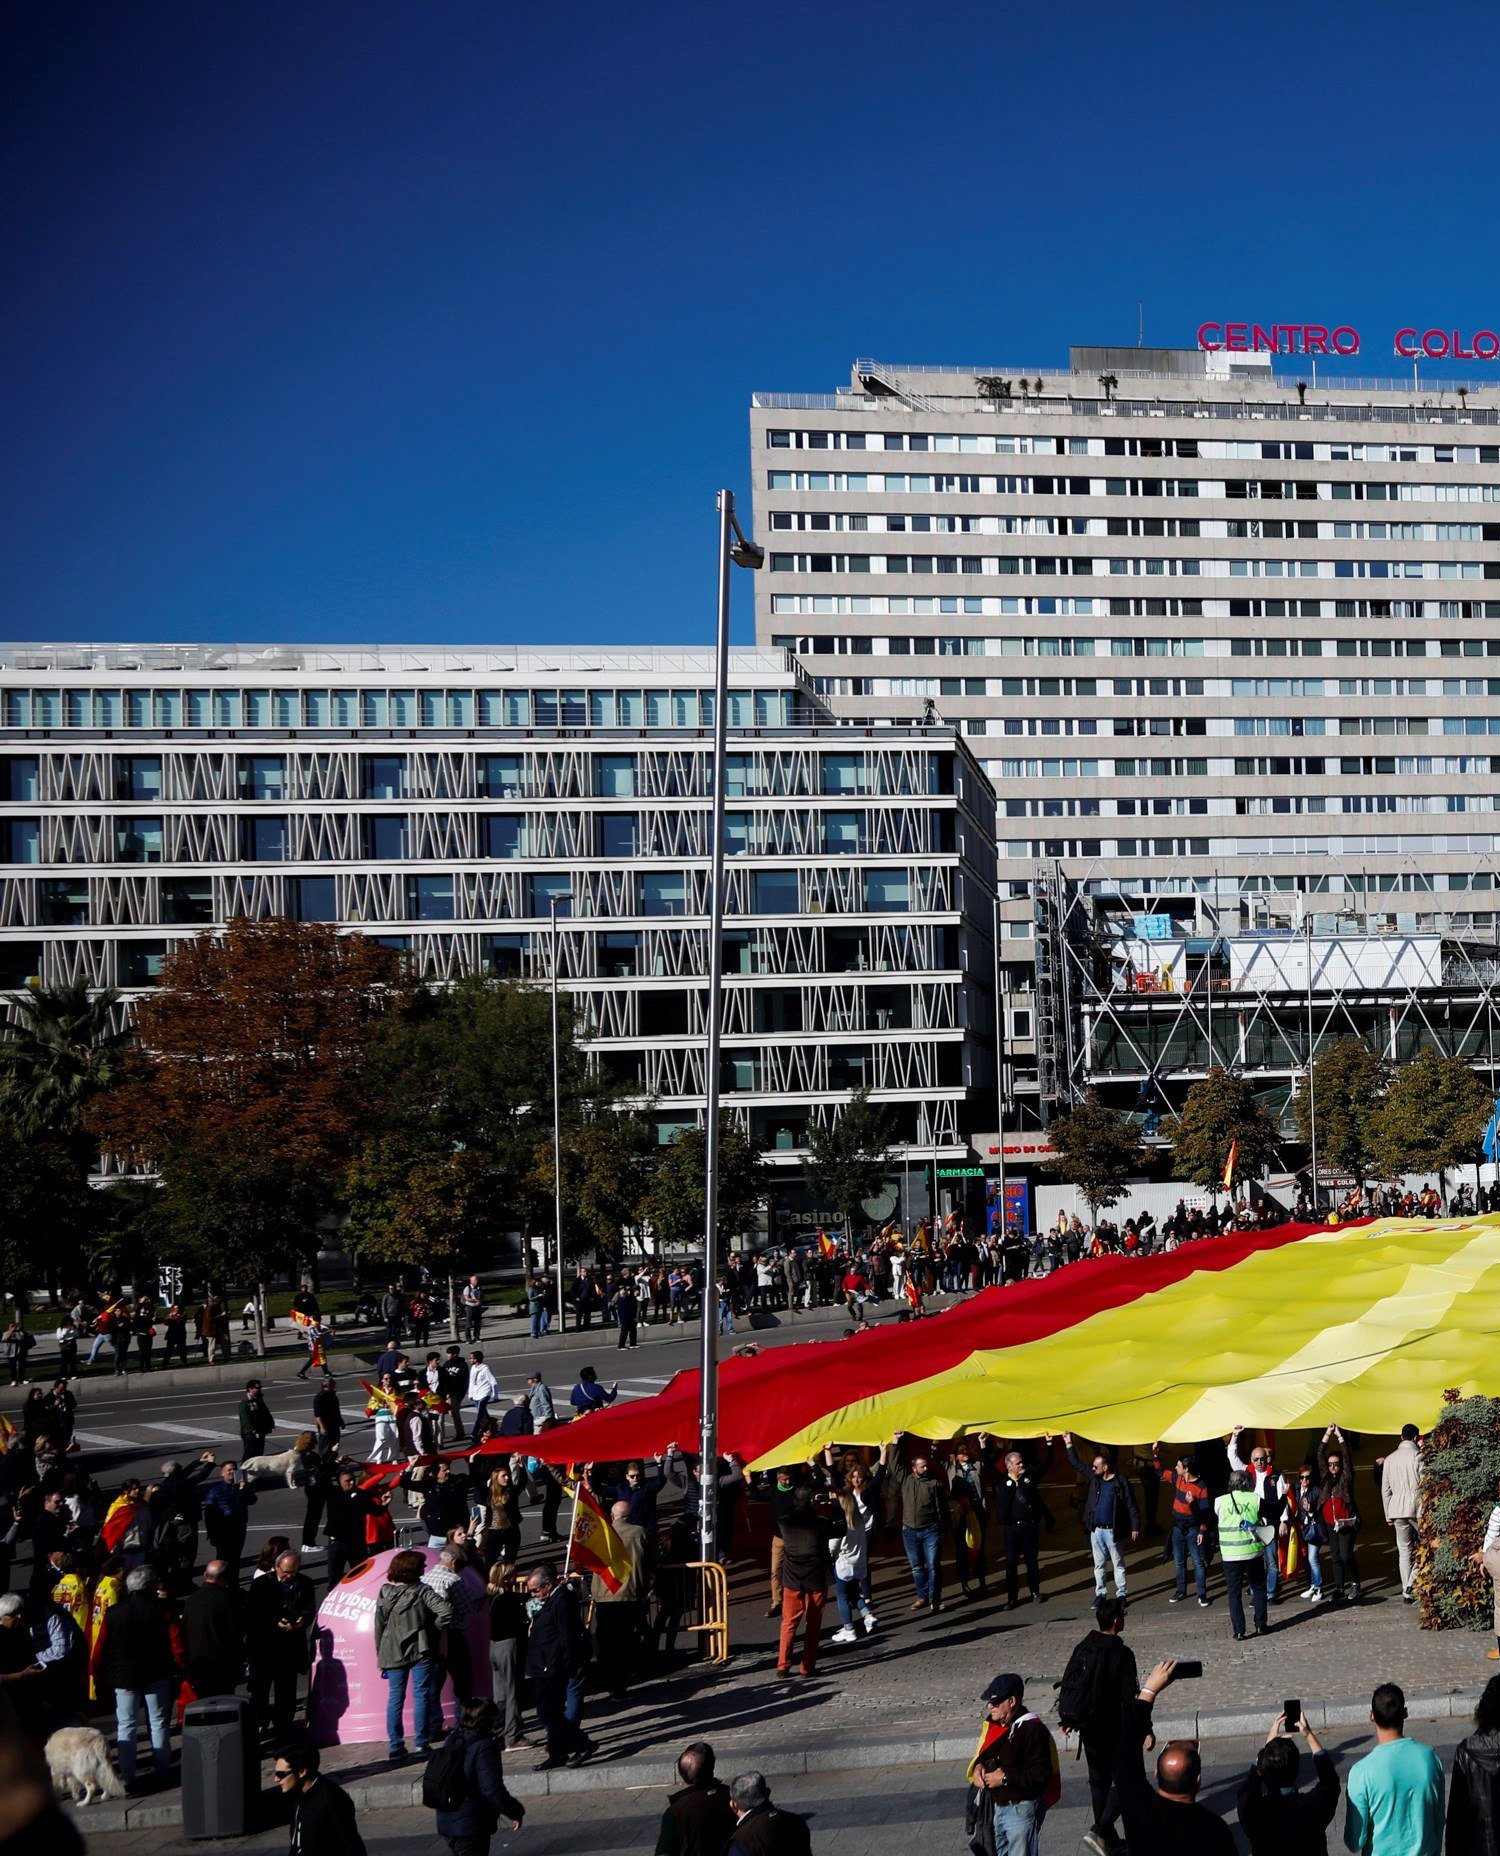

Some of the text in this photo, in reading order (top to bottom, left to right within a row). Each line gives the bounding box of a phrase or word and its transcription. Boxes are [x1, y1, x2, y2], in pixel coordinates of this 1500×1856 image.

[1197, 322, 1360, 355] CENTRO
[1023, 1145, 1036, 1153] DE
[936, 1168, 984, 1177] FARMACIA
[776, 1208, 844, 1226] Casino
[1227, 1501, 1251, 1516] VOX
[338, 1591, 377, 1613] VIDRI
[322, 1602, 361, 1621] ELLAS
